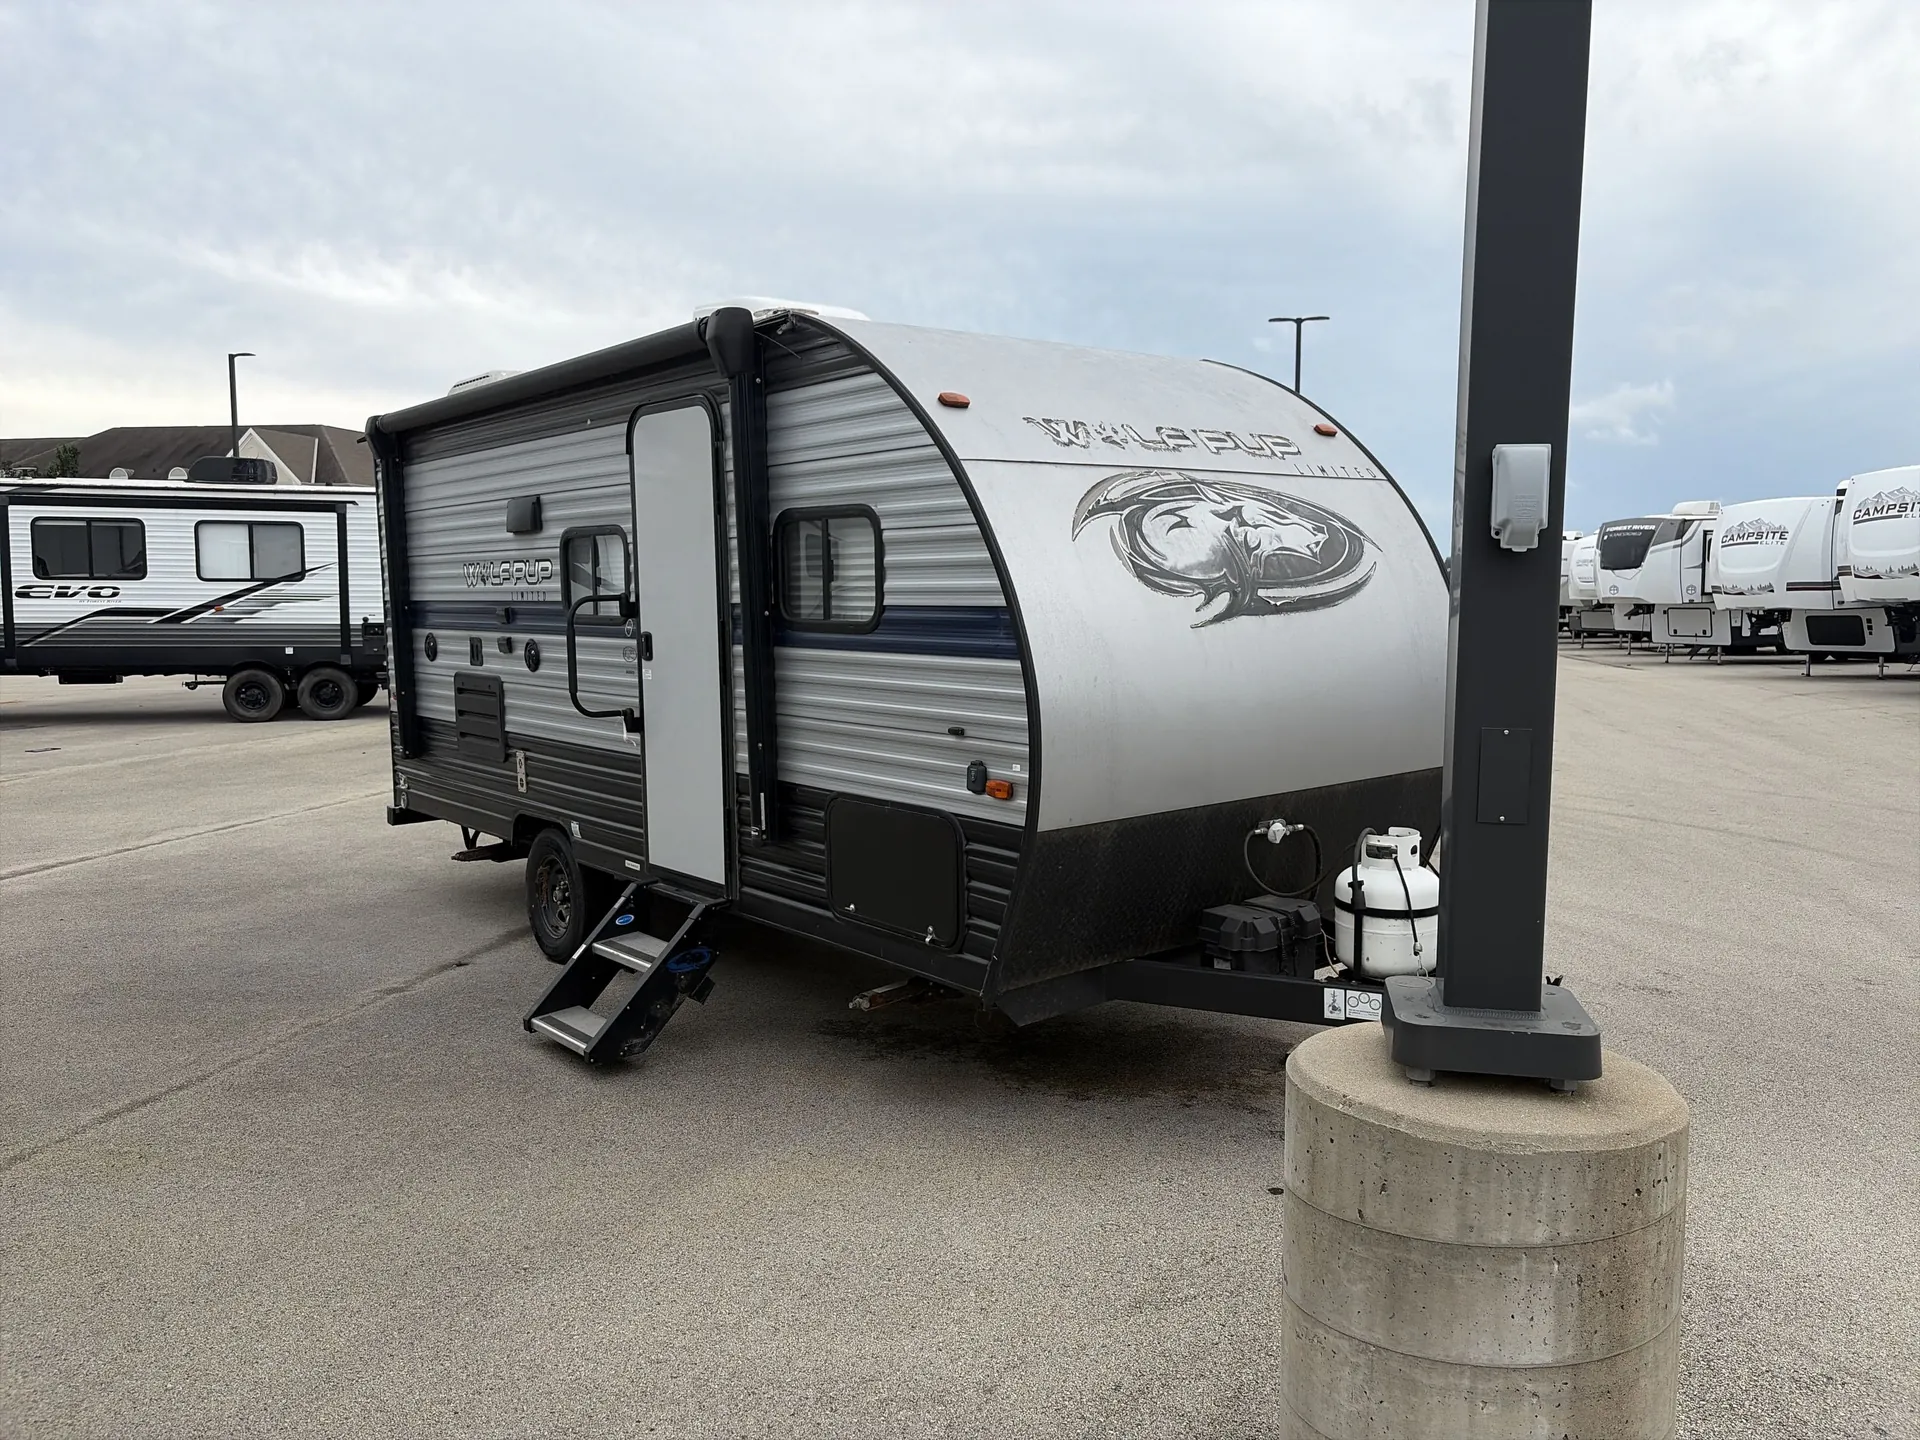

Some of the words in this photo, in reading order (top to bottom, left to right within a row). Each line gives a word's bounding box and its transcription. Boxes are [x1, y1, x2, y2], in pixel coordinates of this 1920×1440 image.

[1293, 463, 1377, 478] LIMITED
[1852, 501, 1920, 520] CAMPSI
[1721, 530, 1790, 544] CAMPSITE
[14, 584, 121, 599] EVO
